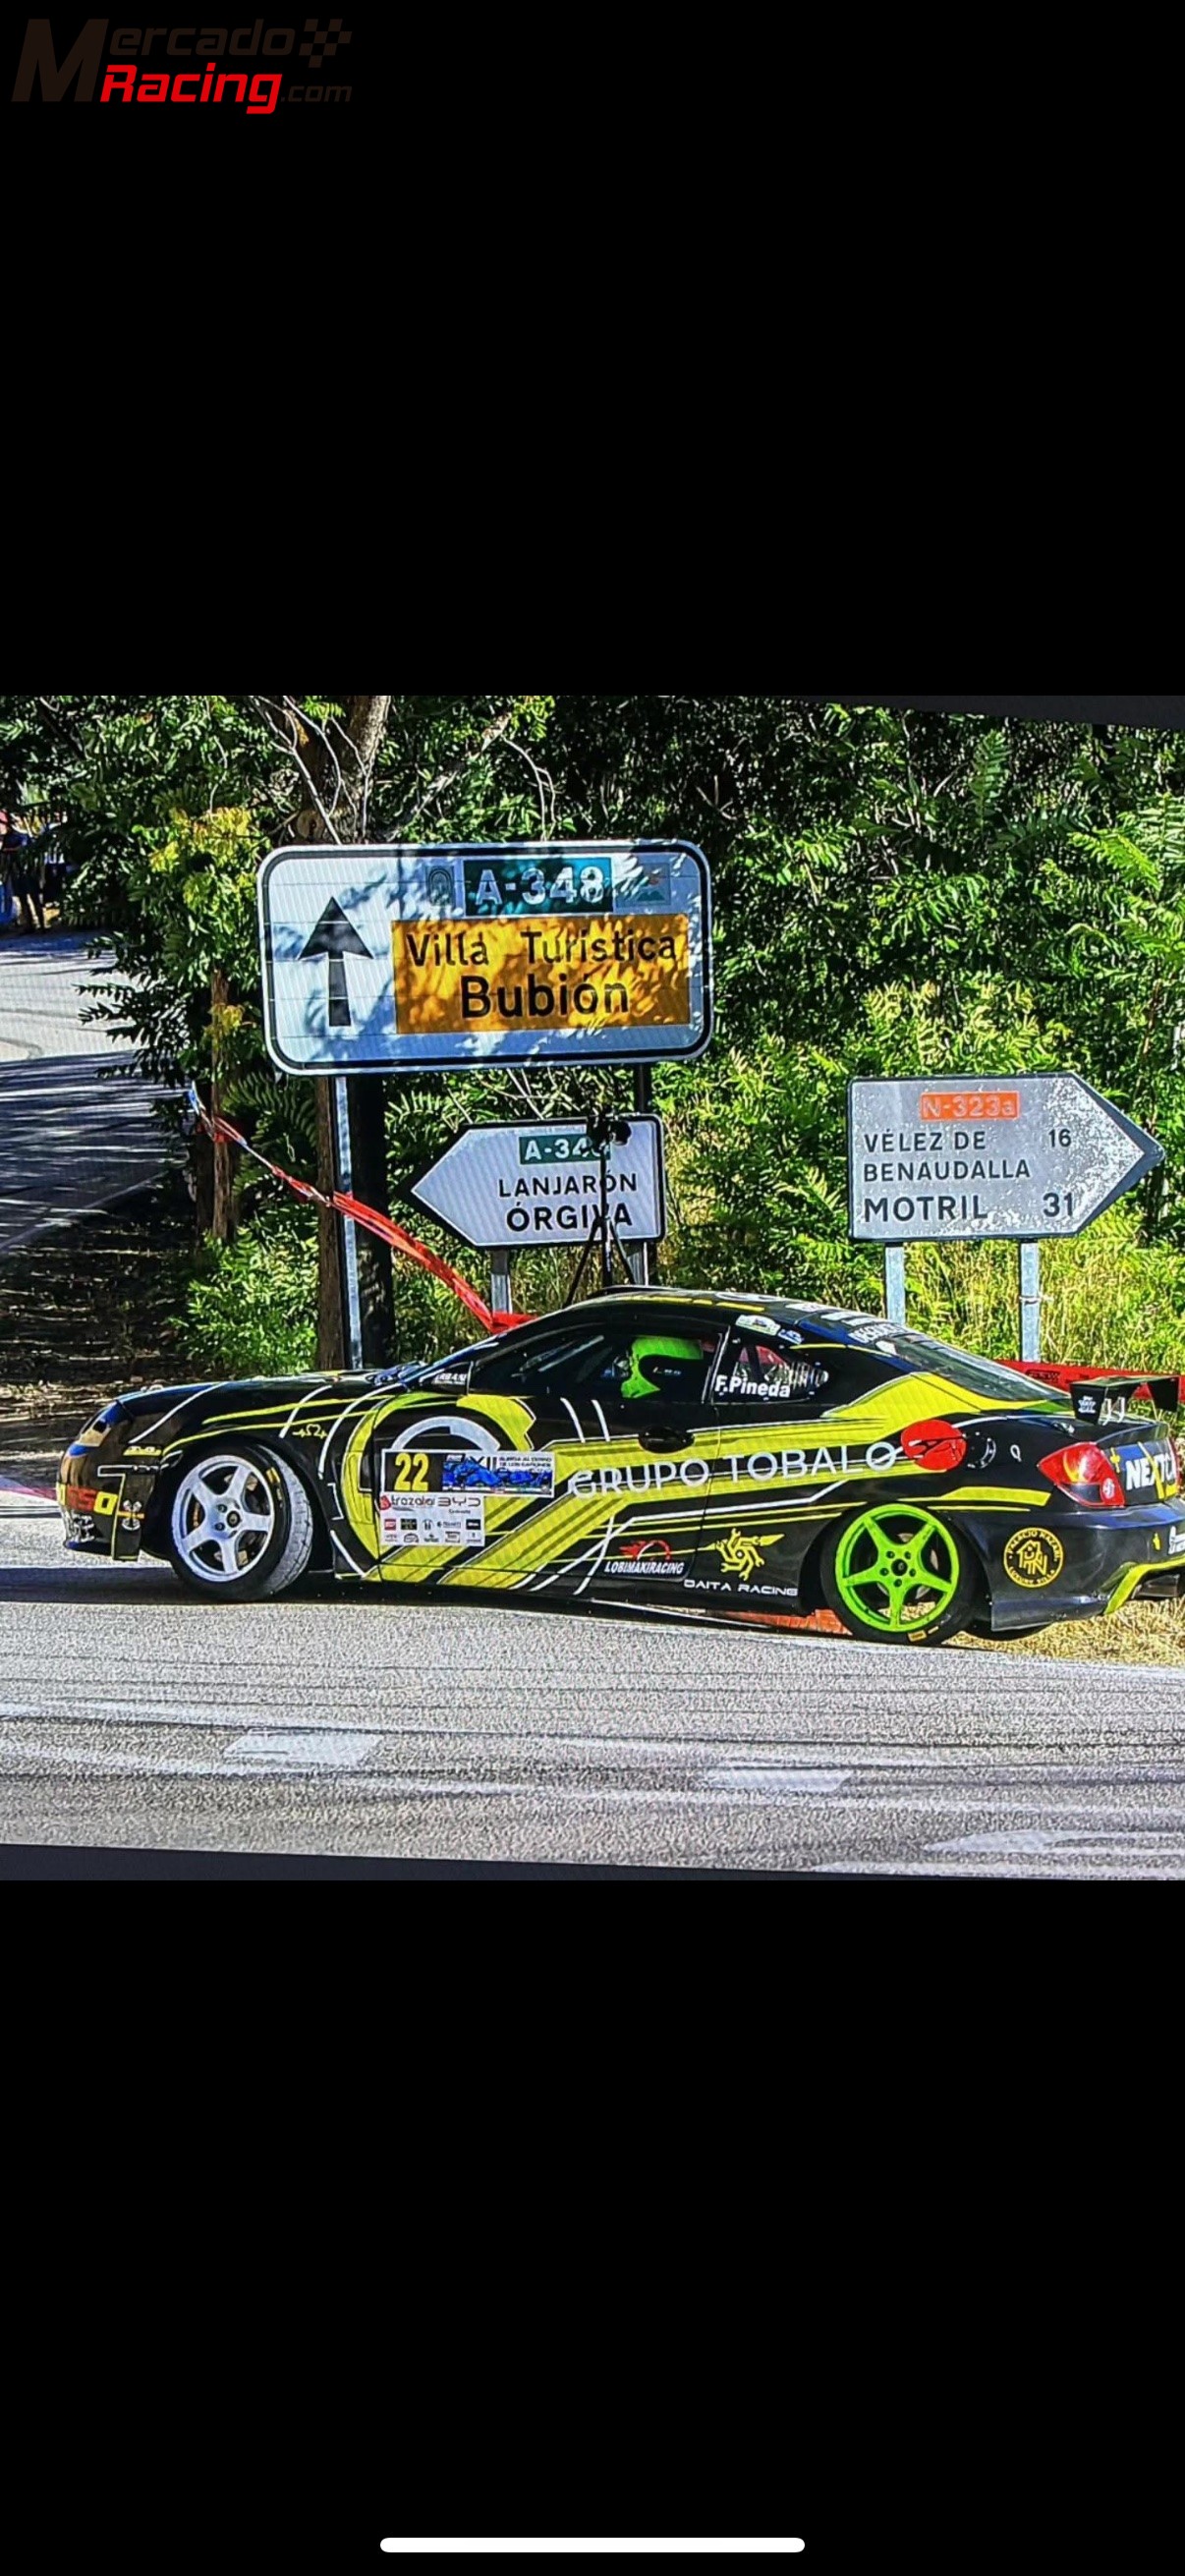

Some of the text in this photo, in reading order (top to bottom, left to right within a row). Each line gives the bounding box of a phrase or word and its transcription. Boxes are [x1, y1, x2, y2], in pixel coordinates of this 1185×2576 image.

[477, 868, 604, 906] A-348
[406, 932, 489, 967] Villa
[461, 970, 630, 1019] Bubión
[922, 1094, 1017, 1118] N-323a
[864, 1129, 1072, 1152] VÉLEZ DE 16
[498, 1170, 637, 1198] LANJARÓN
[864, 1159, 1031, 1182] BENAUDALLA
[506, 1203, 633, 1232] ÓRGIVA
[864, 1193, 1074, 1222] MOTRIL 31
[714, 1374, 791, 1398] F.Pineda
[394, 1452, 429, 1491] 22
[572, 1441, 897, 1499] GRUPO TOBALO
[437, 1496, 481, 1507] BYD
[738, 1584, 799, 1596] RACING
